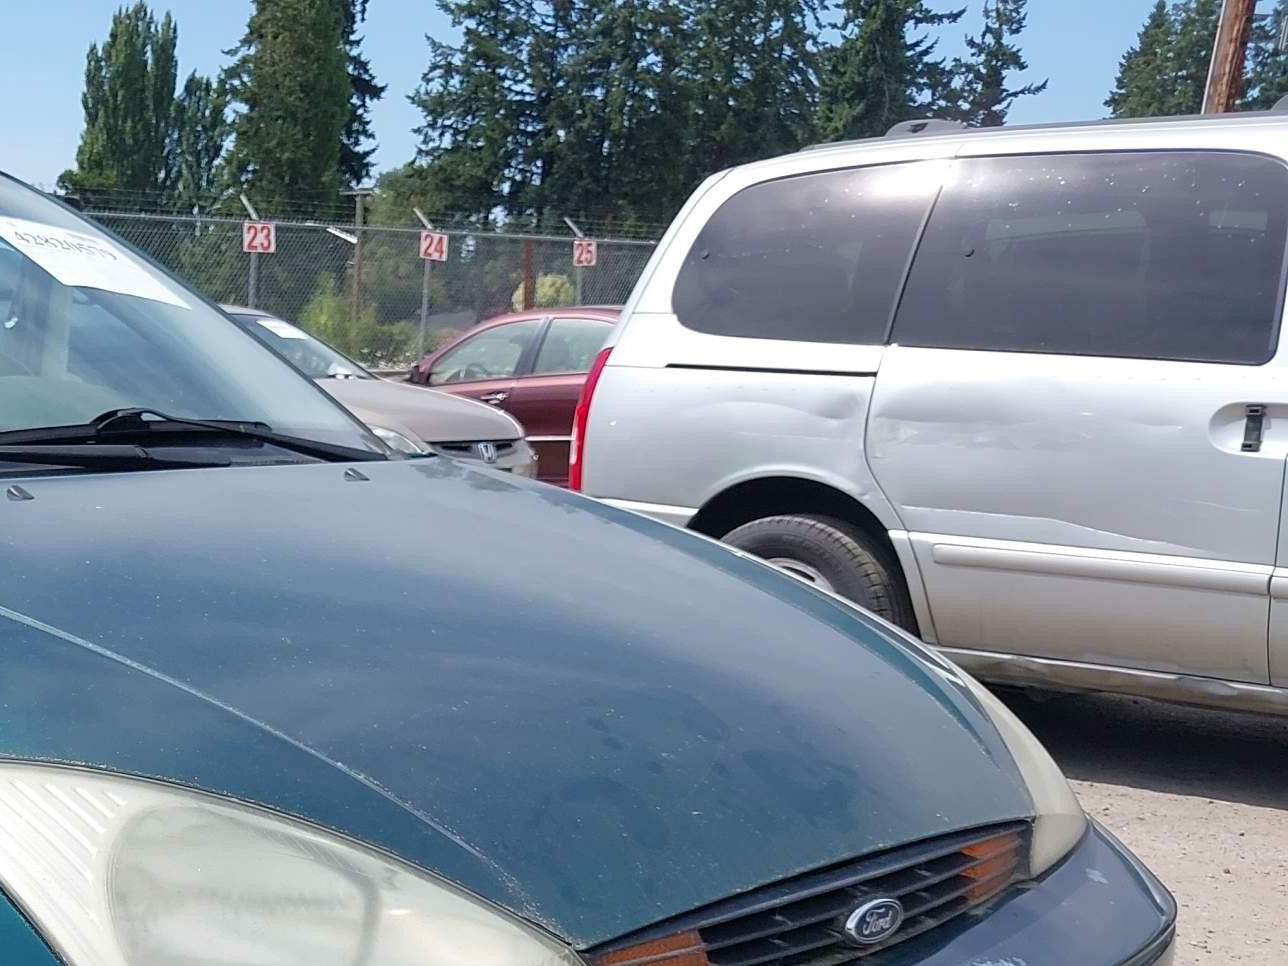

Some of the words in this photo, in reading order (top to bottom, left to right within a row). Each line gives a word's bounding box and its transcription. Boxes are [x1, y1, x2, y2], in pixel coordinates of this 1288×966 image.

[247, 224, 271, 251] 23
[423, 233, 445, 259] 24
[576, 242, 594, 265] 25
[862, 906, 893, 936] Ford
